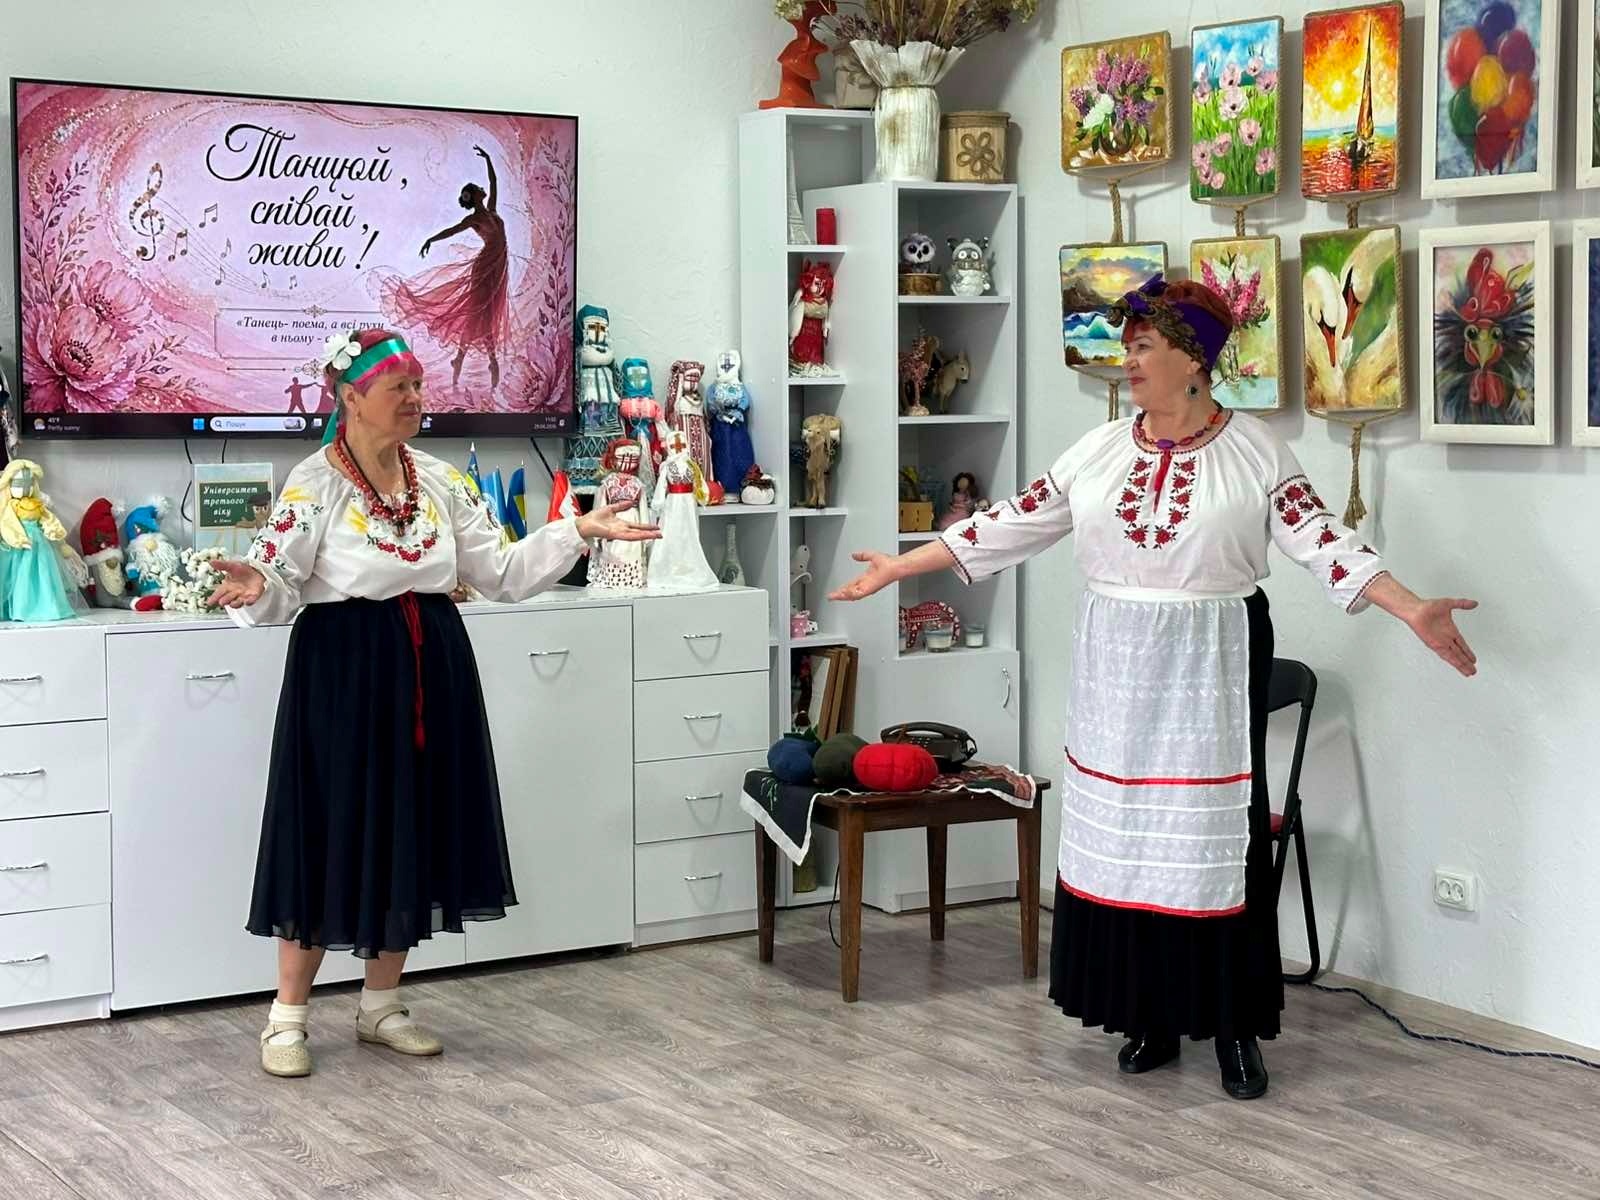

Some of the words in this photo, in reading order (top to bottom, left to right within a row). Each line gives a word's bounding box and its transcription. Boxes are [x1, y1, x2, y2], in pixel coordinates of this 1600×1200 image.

[291, 319, 328, 330] поема,
[330, 321, 338, 329] а
[340, 319, 357, 330] всі
[271, 334, 277, 343] в
[280, 334, 315, 346] ньому
[203, 485, 258, 496] Університет
[203, 498, 245, 507] третього
[213, 507, 232, 518] віку
